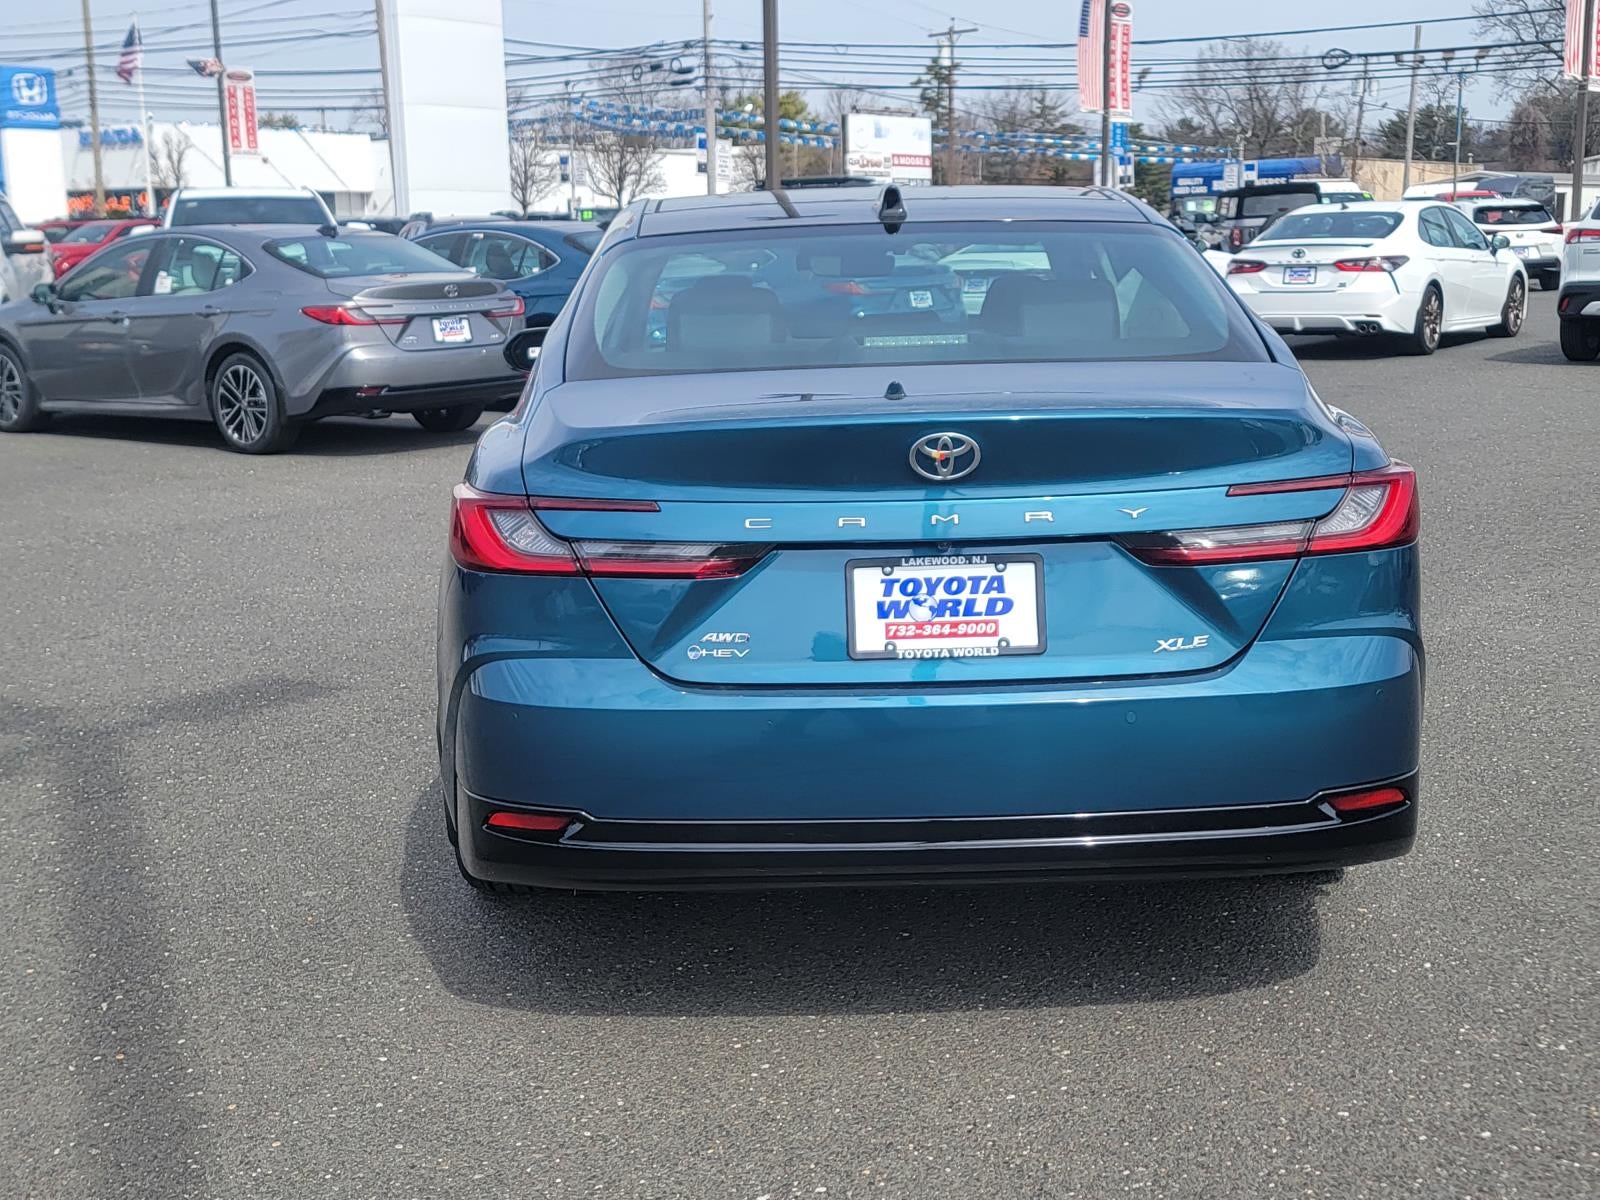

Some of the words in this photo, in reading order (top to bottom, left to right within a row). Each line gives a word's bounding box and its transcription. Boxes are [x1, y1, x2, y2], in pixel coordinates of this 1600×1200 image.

[229, 85, 240, 148] TOYOTA
[744, 506, 1148, 530] CAMRY
[971, 555, 988, 565] NJ
[880, 575, 1006, 598] TOYOTA
[876, 596, 1014, 620] WORLD
[701, 632, 751, 643] AWD
[887, 622, 996, 638] 732-364-9000
[896, 648, 950, 659] TOYOTA
[952, 646, 1000, 657] WORLD
[1153, 634, 1210, 653] XLE
